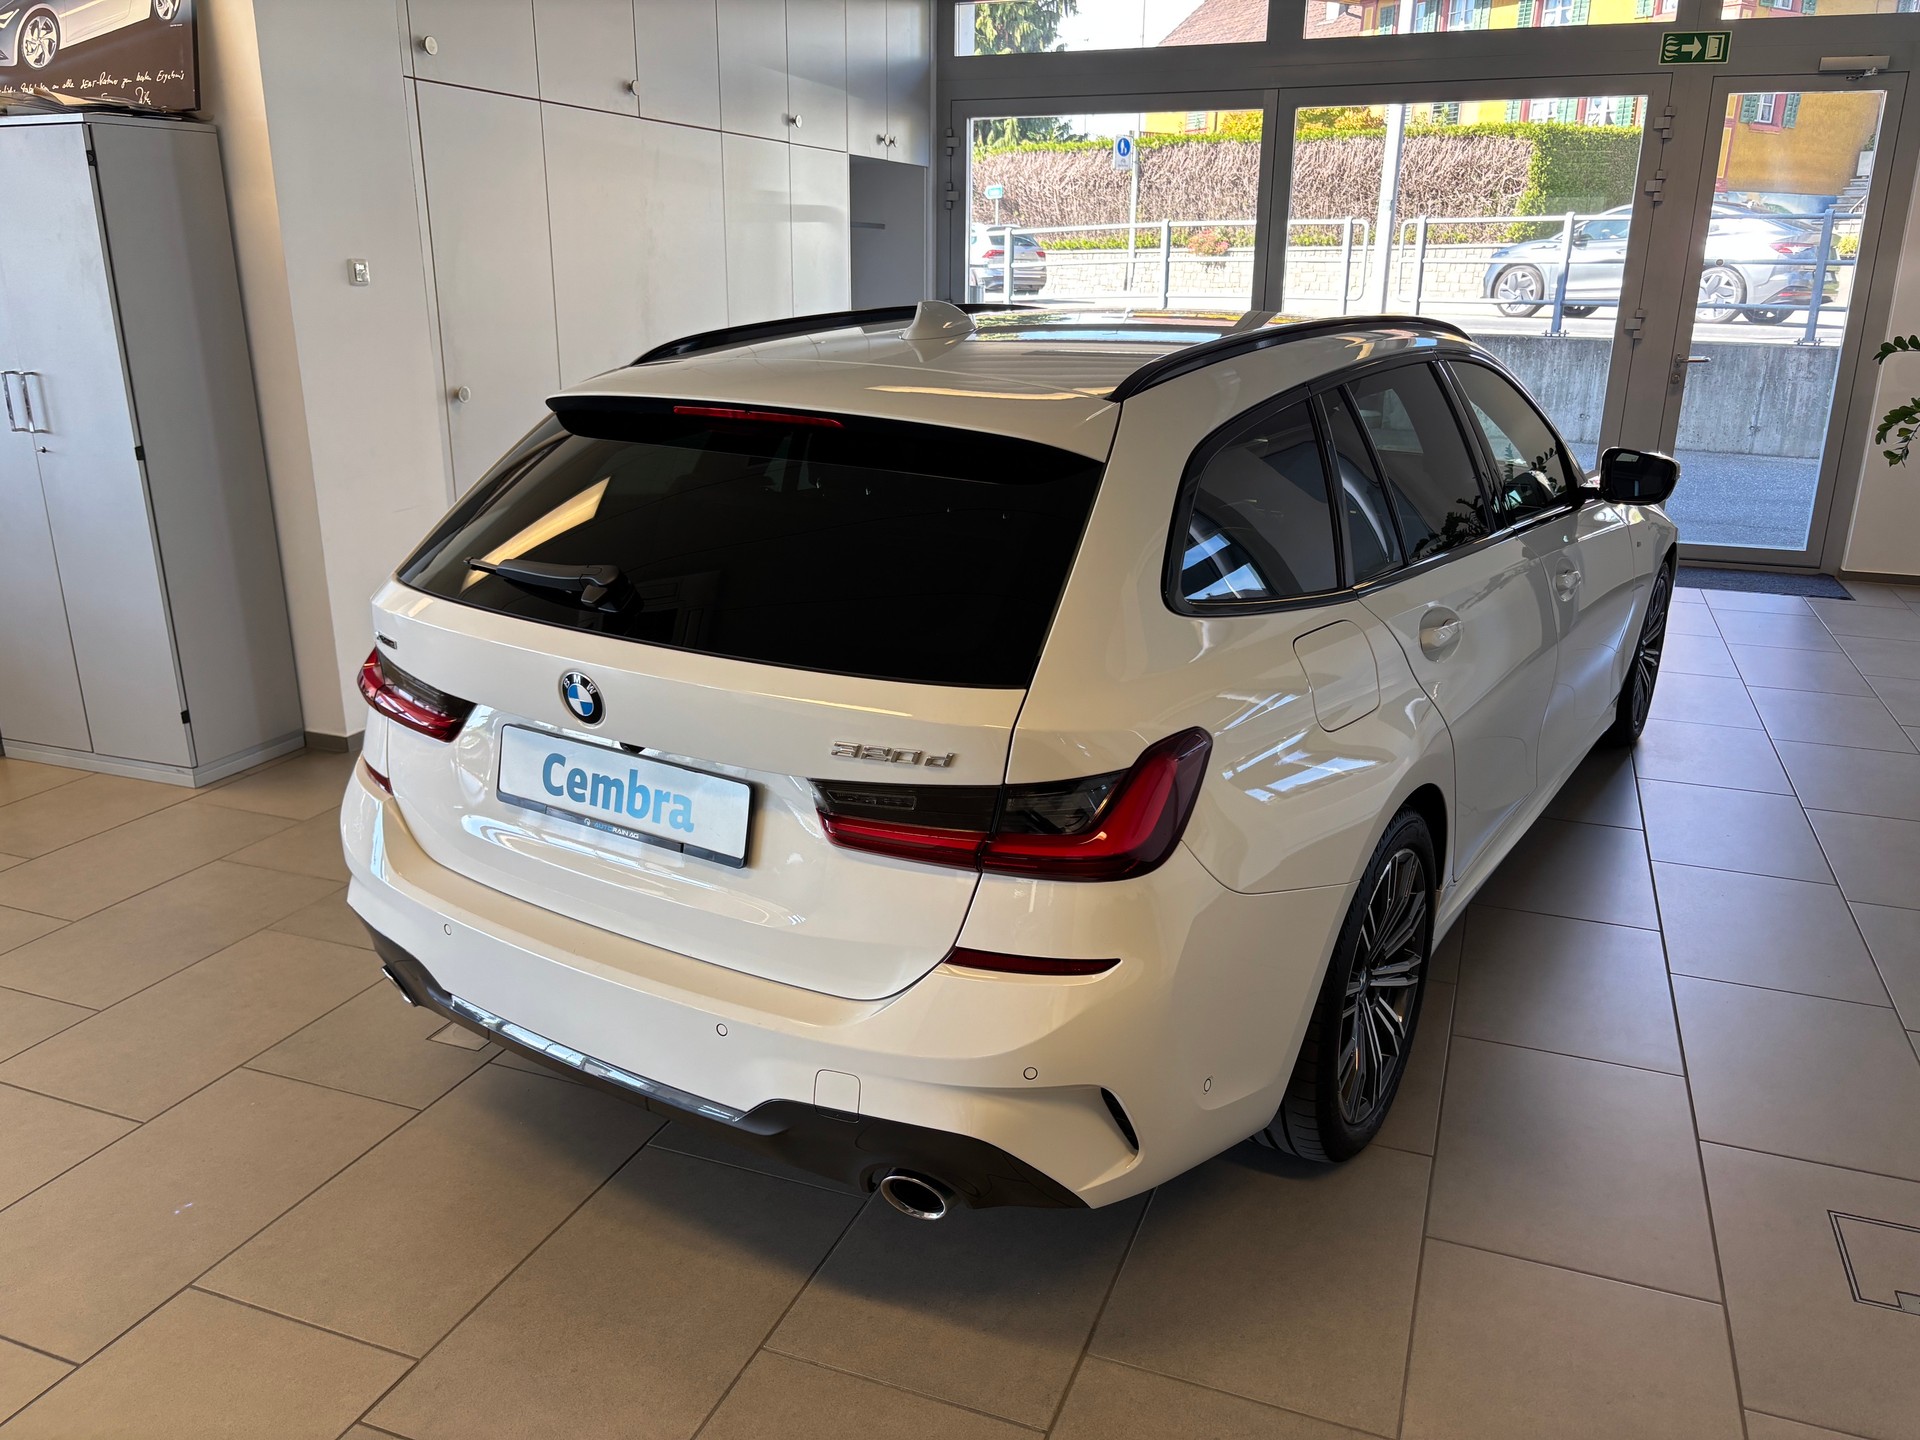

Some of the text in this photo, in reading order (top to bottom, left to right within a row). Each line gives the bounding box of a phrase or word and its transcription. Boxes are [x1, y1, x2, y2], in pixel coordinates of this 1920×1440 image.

[563, 673, 597, 695] BMW
[831, 741, 955, 768] 320d
[542, 752, 695, 833] Cembra
